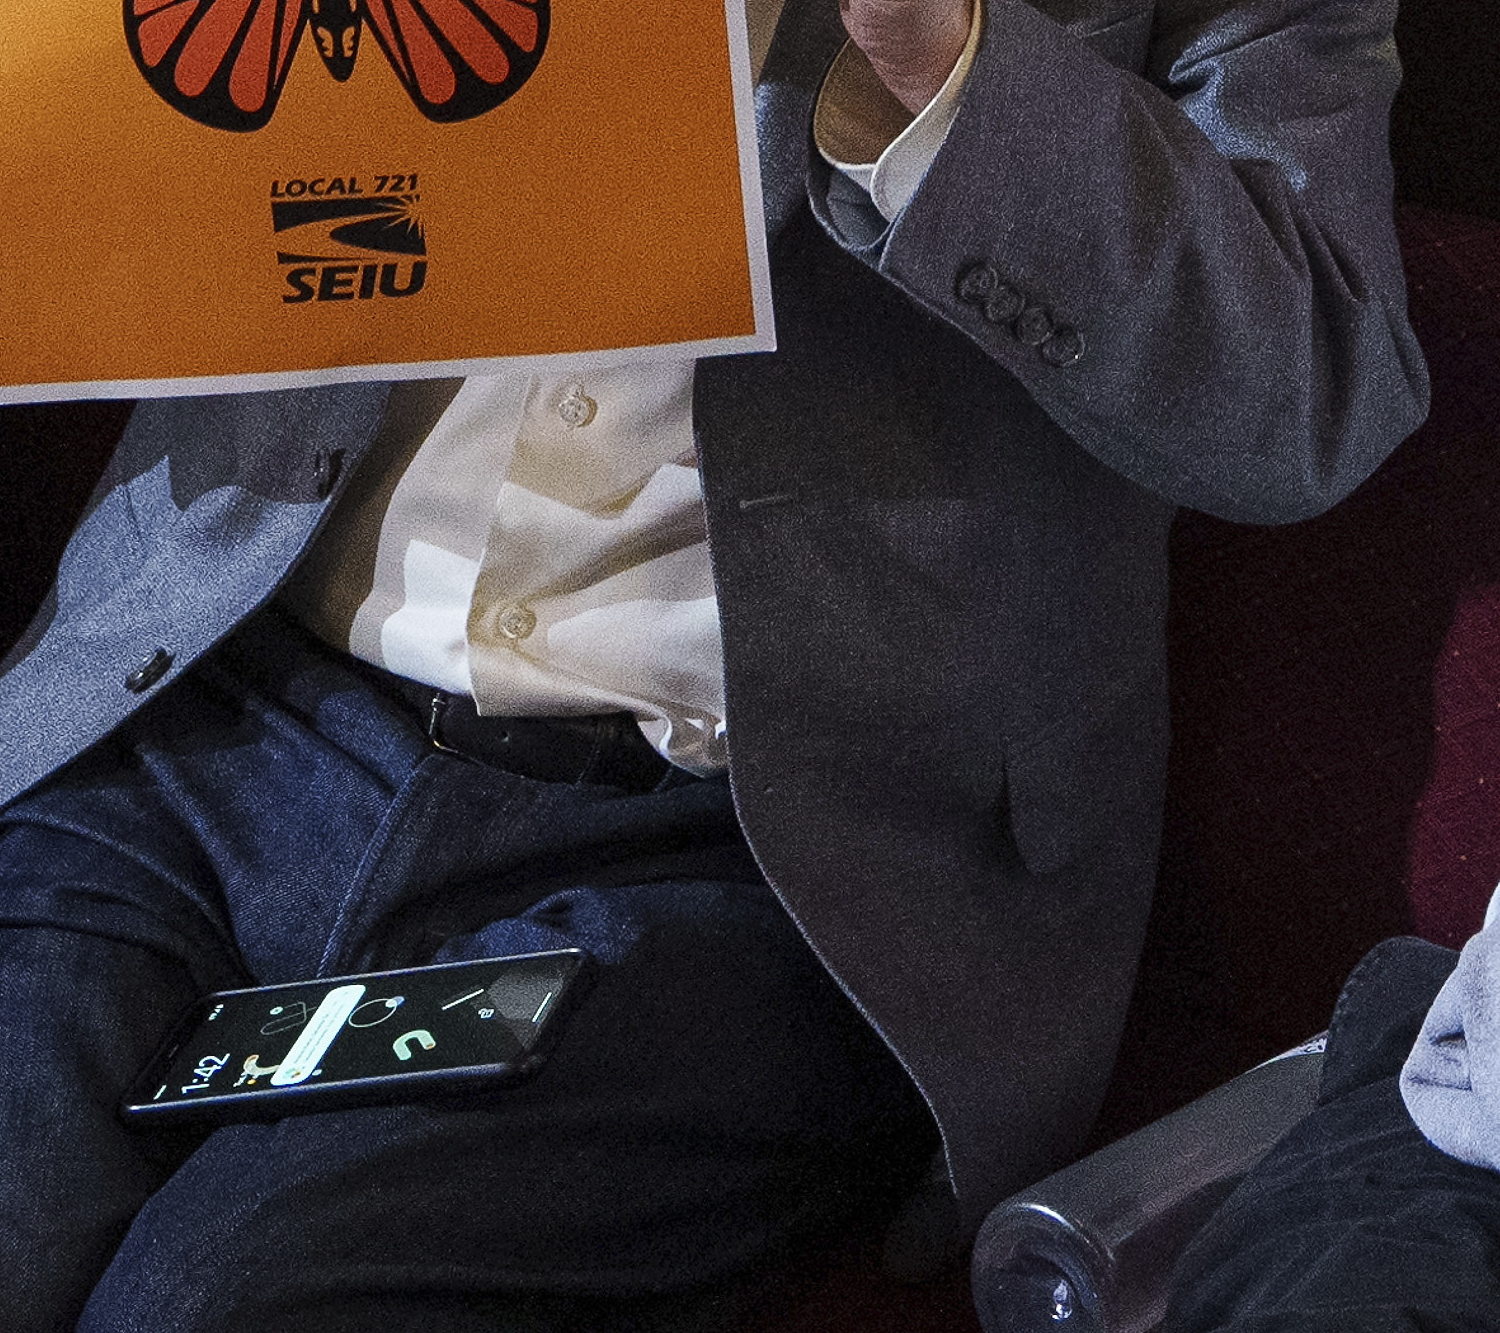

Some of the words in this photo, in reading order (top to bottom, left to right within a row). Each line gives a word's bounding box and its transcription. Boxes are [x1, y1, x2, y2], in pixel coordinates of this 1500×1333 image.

[270, 177, 364, 198] LOCAL
[373, 173, 419, 193] 721
[283, 260, 428, 304] SEIU
[181, 1052, 231, 1095] 1:42
